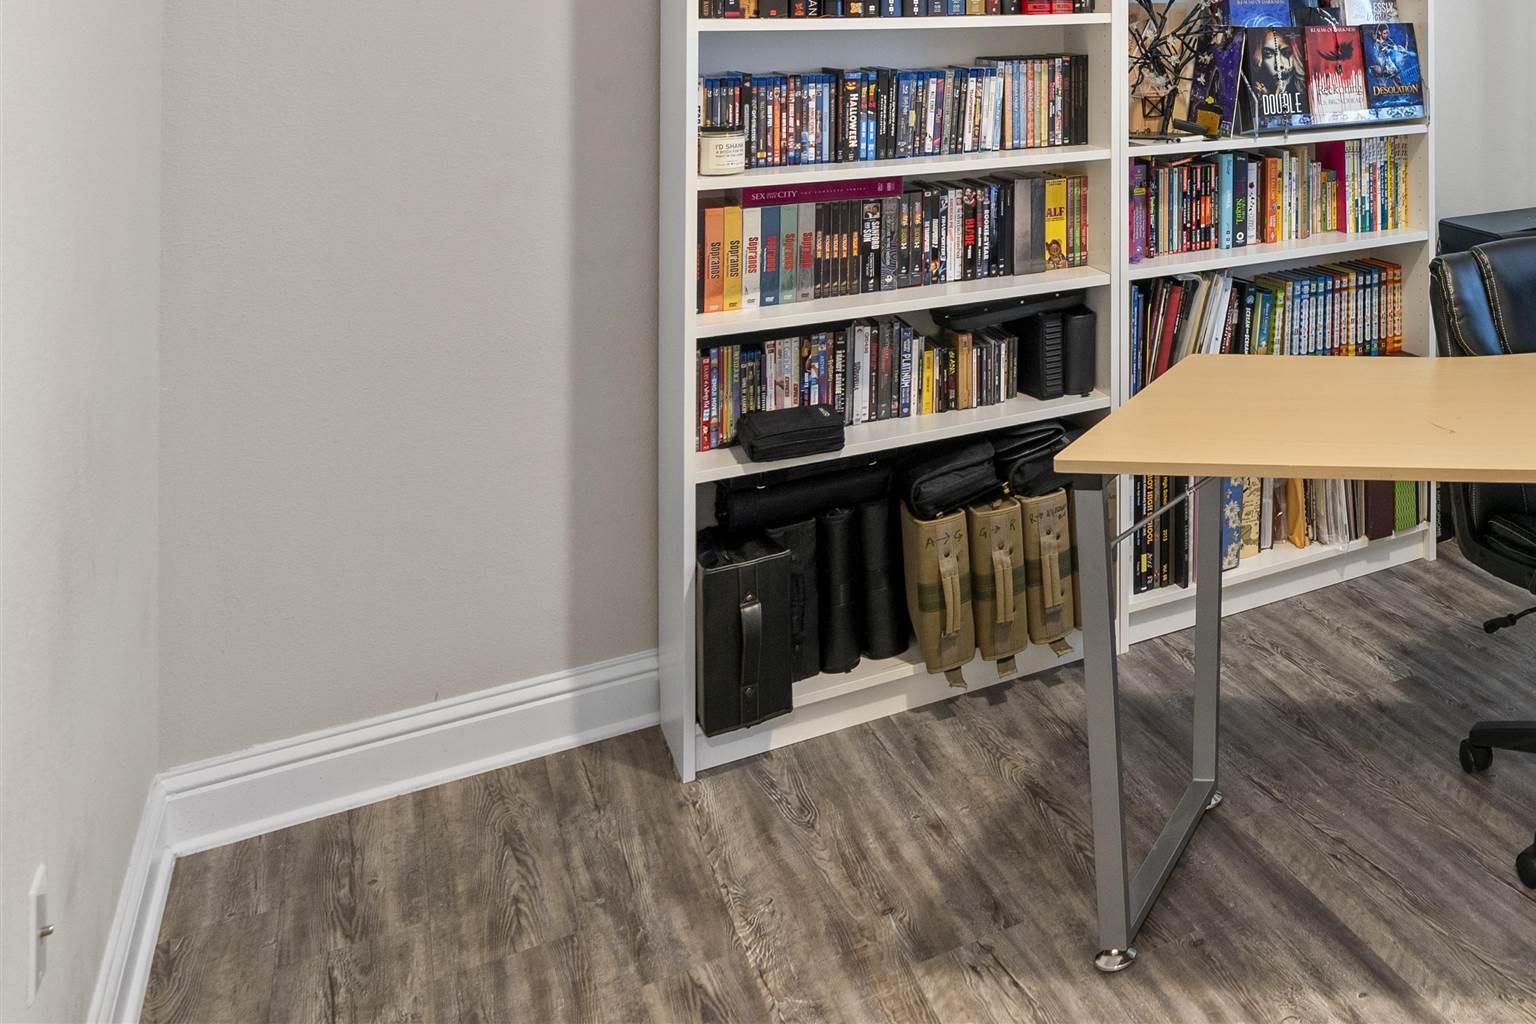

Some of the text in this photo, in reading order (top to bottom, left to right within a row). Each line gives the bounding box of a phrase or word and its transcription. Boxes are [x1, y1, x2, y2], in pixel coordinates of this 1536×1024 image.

[1263, 93, 1302, 115] DOUBLE
[1373, 84, 1418, 96] DESOLATION
[848, 93, 858, 147] HALLOWEEN
[777, 191, 798, 199] CITY
[1045, 206, 1065, 218] ALF
[863, 228, 871, 242] SON
[871, 221, 880, 249] SANFORD
[965, 218, 975, 246] BLADE
[710, 242, 721, 279] Sopranos
[728, 240, 740, 278] Sopranos
[747, 236, 758, 274] Sopranos
[783, 233, 795, 271] Sopranos
[802, 232, 813, 269] Sopranos
[901, 354, 911, 387] PLATINUM
